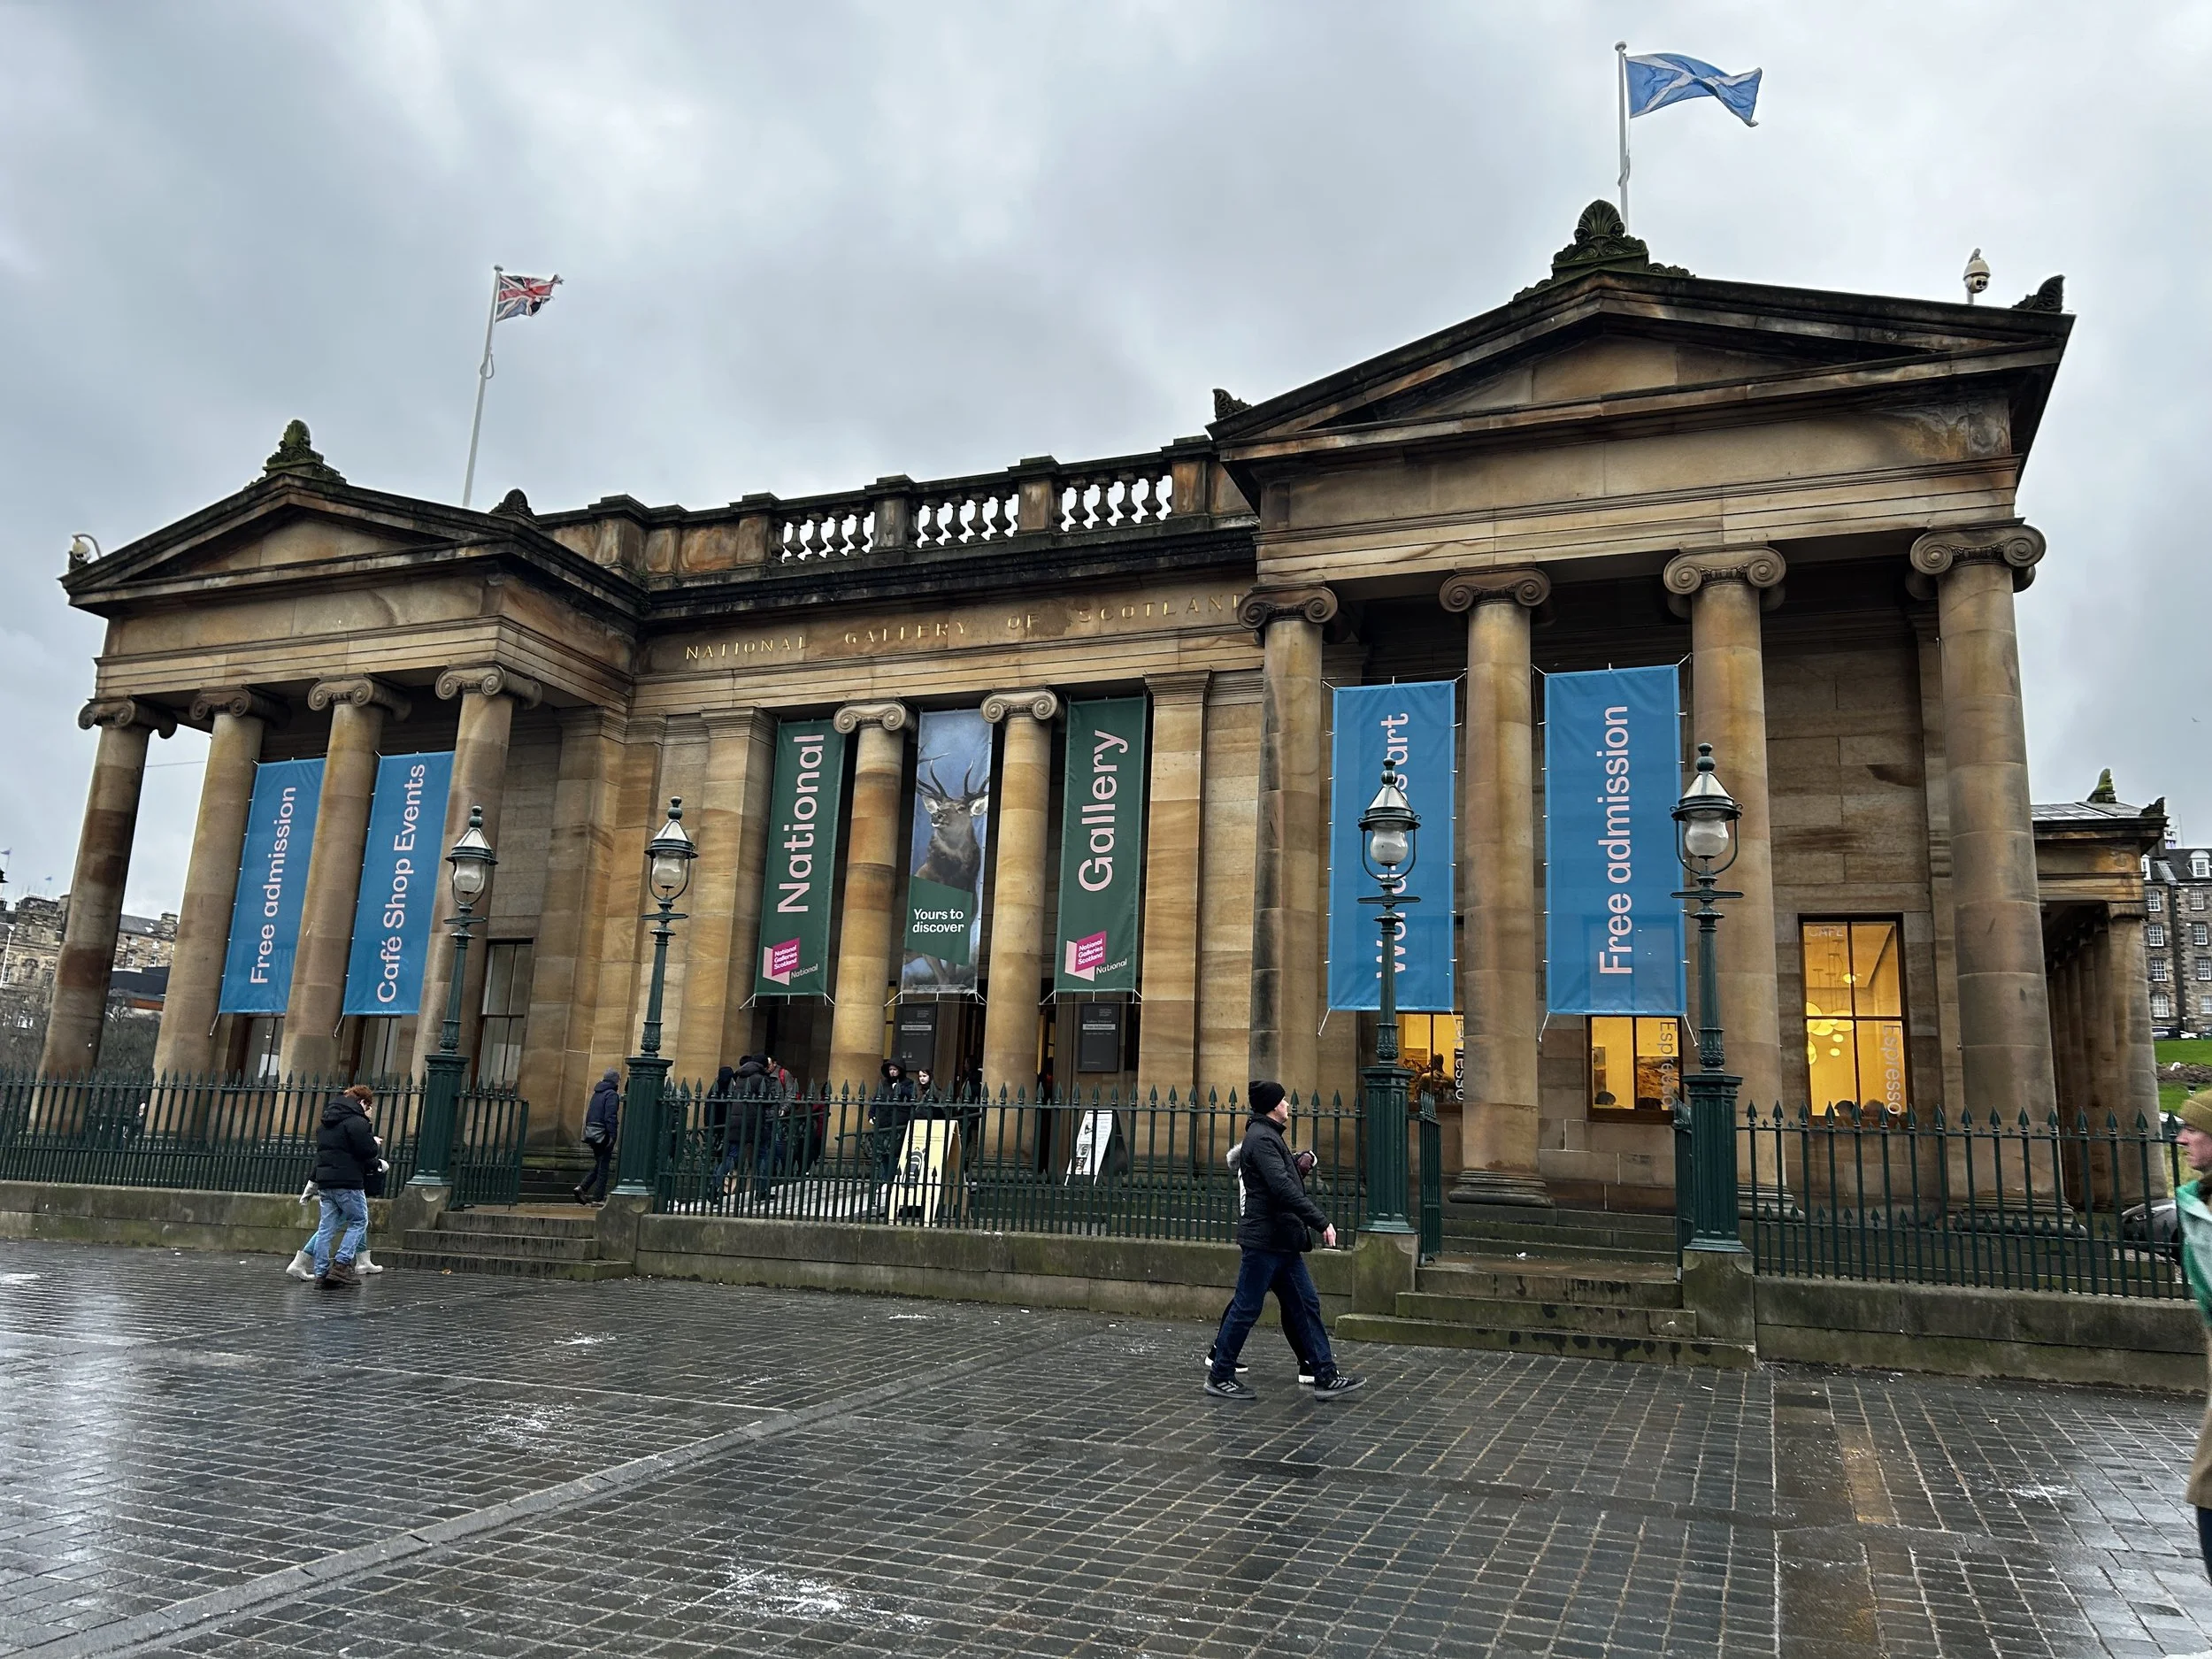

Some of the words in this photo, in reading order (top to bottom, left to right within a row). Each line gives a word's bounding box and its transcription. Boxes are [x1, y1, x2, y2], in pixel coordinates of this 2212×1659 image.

[686, 634, 810, 661] NATIONAL
[844, 621, 969, 645] GALLERY
[1008, 614, 1040, 630] OF
[1380, 713, 1409, 765] art
[393, 764, 426, 851] Events
[1078, 730, 1128, 892] Gallery
[1596, 706, 1632, 885] admission
[777, 734, 825, 913] National
[250, 924, 275, 983] Free
[263, 787, 296, 918] admission
[384, 858, 414, 930] Shop
[912, 921, 964, 933] discover
[913, 908, 949, 920] Yours
[949, 908, 964, 919] to
[1599, 893, 1632, 974] Free
[377, 936, 403, 1002] Café
[773, 957, 797, 970] Scotland
[774, 944, 797, 956] National
[1078, 946, 1103, 958] Galleries
[1078, 952, 1103, 965] Scotland
[1079, 938, 1103, 952] National
[1096, 957, 1128, 975] National
[790, 963, 818, 979] National
[1881, 1025, 1902, 1116] Espresso
